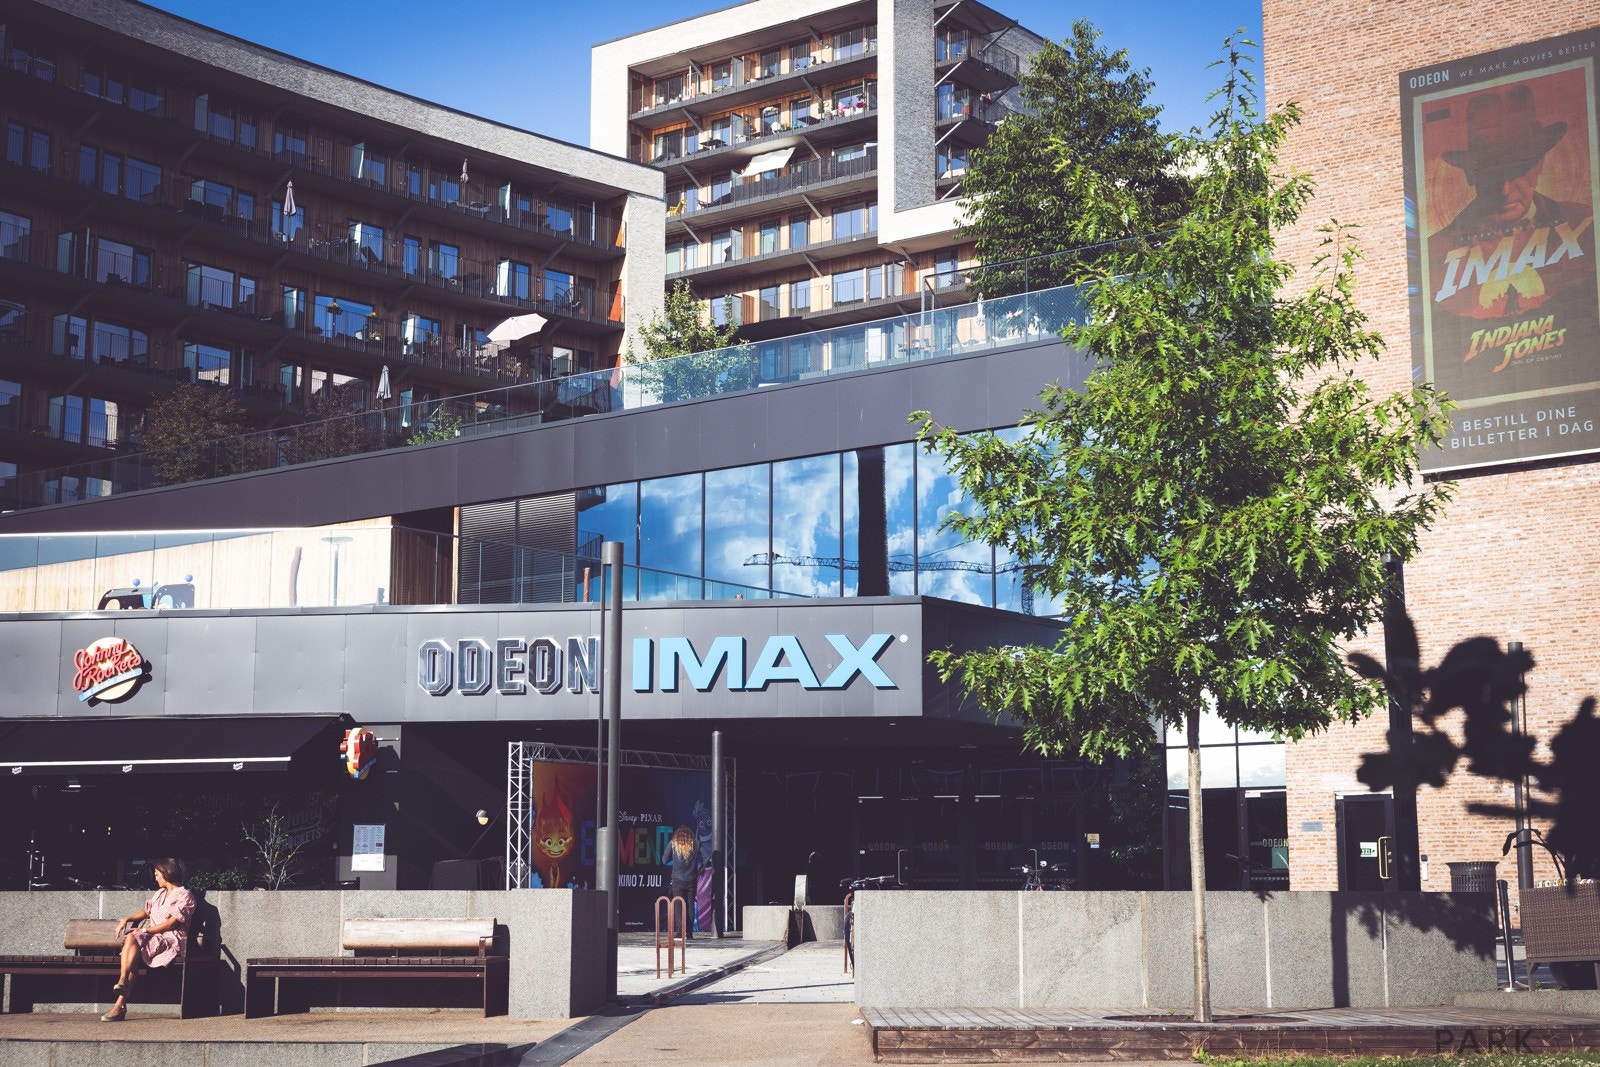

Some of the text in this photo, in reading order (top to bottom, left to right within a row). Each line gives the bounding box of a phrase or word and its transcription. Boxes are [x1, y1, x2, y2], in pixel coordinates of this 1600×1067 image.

[1409, 41, 1596, 89] ODEON WE MAKE MOVIES BETTER
[1434, 216, 1594, 303] IMAX
[1463, 314, 1555, 364] INDIANA
[1492, 327, 1567, 373] JONES
[1451, 420, 1594, 449] BILLETTER I DAG
[1463, 406, 1577, 432] BESTILL DINE
[73, 638, 134, 691] Johnny
[82, 651, 142, 691] Rockets
[418, 634, 900, 695] ODEON IMAX
[640, 813, 663, 823] PIXAR
[985, 842, 1013, 851] ODEON
[1262, 838, 1289, 848] ODEON
[618, 874, 637, 887] KINO
[646, 874, 662, 888] JULI
[1435, 1029, 1535, 1055] PARK
